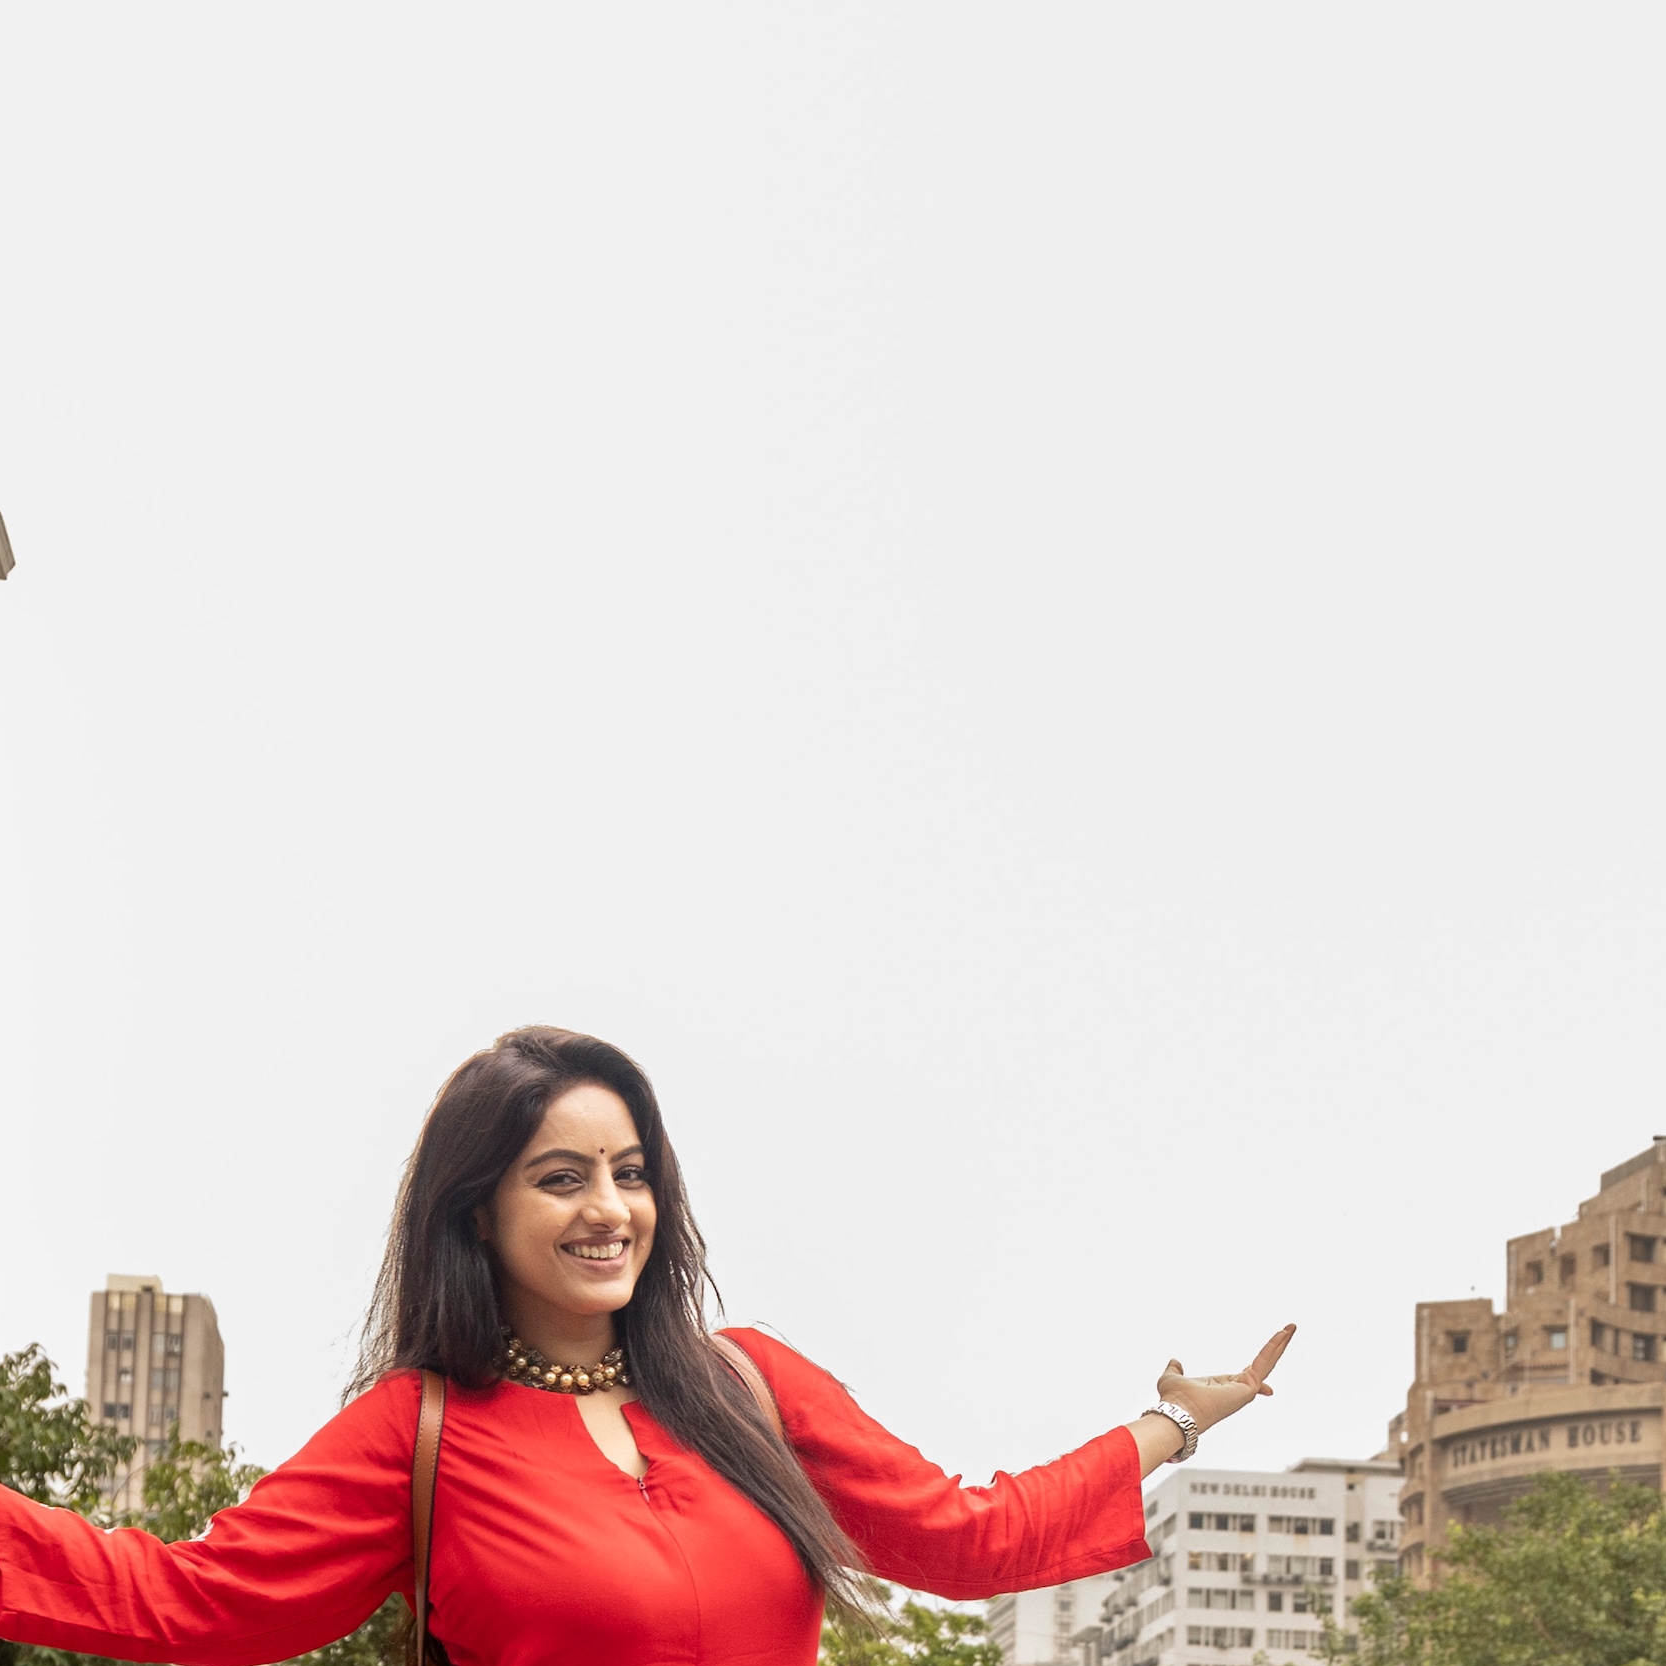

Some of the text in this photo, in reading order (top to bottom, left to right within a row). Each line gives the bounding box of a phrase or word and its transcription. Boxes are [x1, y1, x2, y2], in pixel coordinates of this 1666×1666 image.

[1452, 1419, 1643, 1468] STATESMAN HOUSE
[1189, 1482, 1316, 1500] NEW DELHI HOUSE
